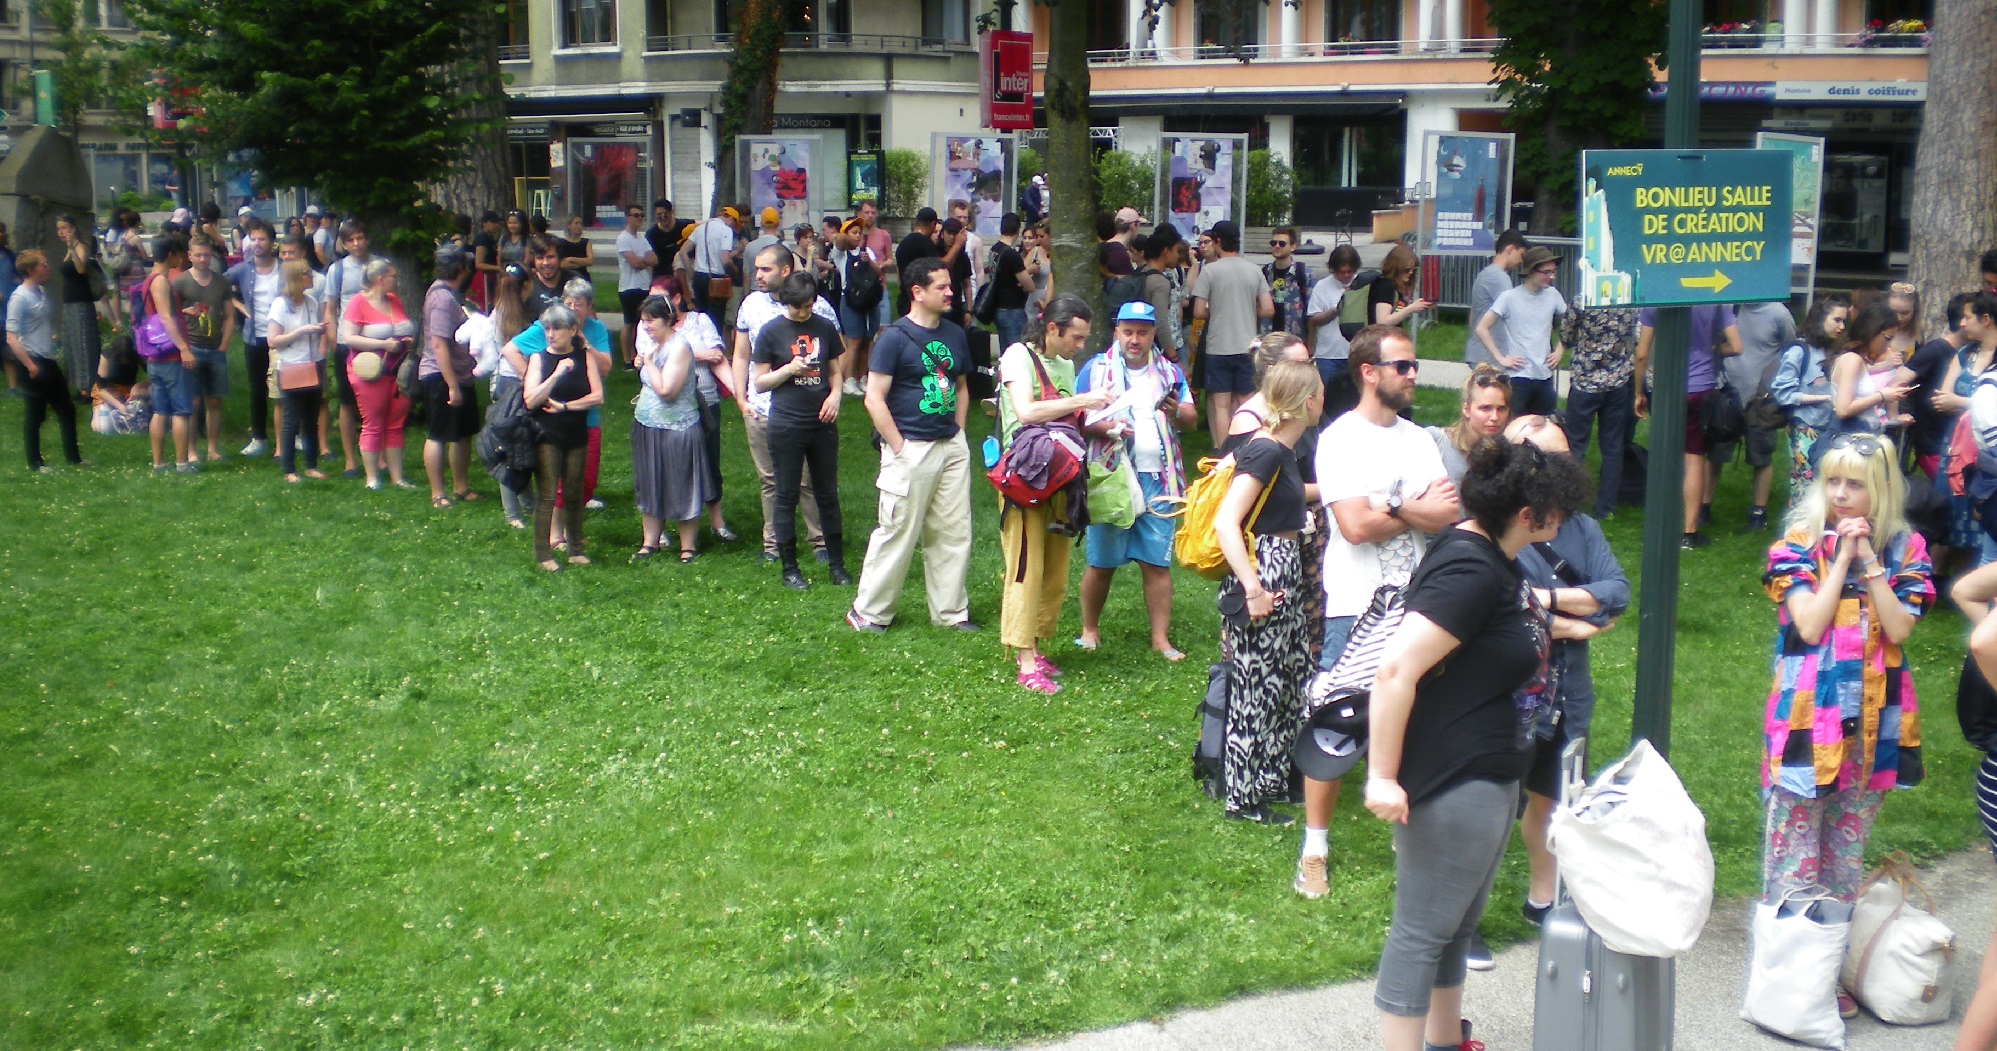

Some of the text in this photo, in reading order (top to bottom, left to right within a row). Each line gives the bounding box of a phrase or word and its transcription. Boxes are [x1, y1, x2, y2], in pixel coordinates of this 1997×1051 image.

[1000, 73, 1029, 91] inter
[1650, 85, 1767, 97] PCING
[1828, 86, 1918, 96] denis coiffure
[781, 118, 831, 127] Montana
[994, 112, 1030, 121] franceinter.fr
[1607, 163, 1643, 176] ANNECY
[1635, 185, 1772, 208] BONLIEU SALLE
[1643, 208, 1764, 235] DE CRÉATION
[794, 377, 821, 385] BEHIND
